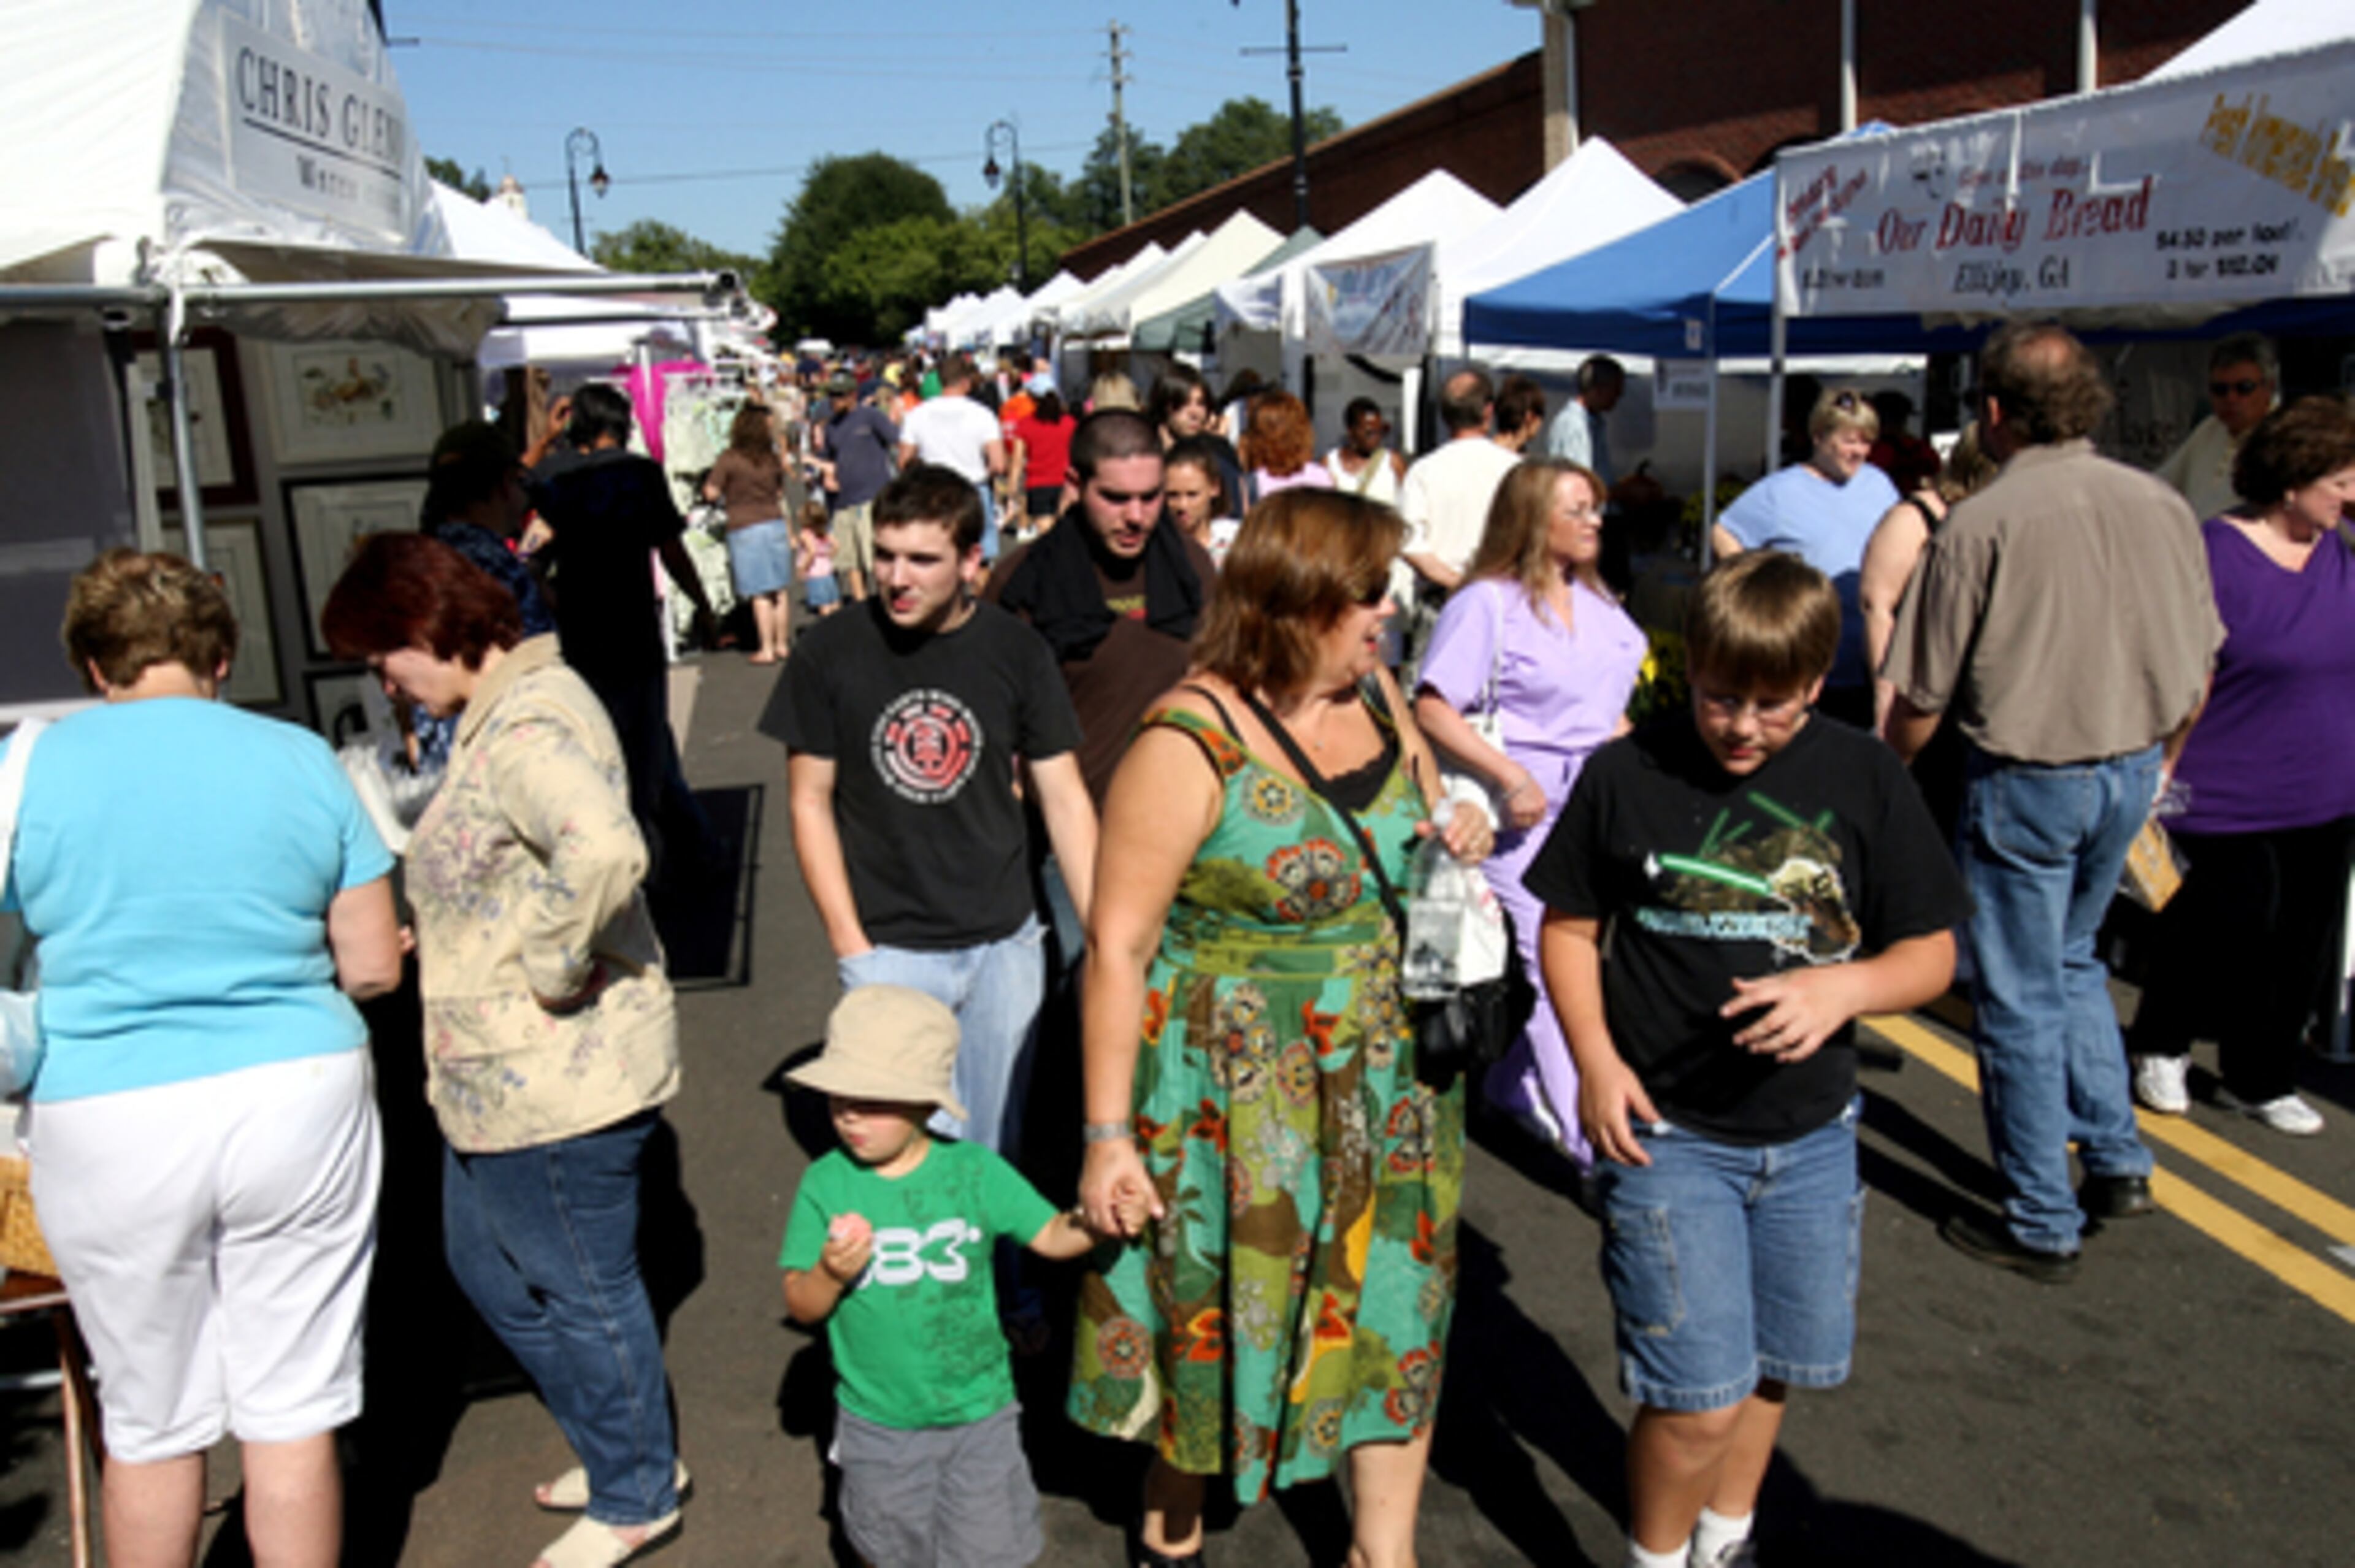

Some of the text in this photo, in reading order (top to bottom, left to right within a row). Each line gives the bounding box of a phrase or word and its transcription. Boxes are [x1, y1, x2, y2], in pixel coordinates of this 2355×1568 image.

[236, 46, 330, 139] CHRIS
[1878, 207, 1924, 254] Our
[1936, 197, 2028, 253] Daily
[2043, 174, 2153, 240] Bread
[857, 1217, 968, 1289] 83
